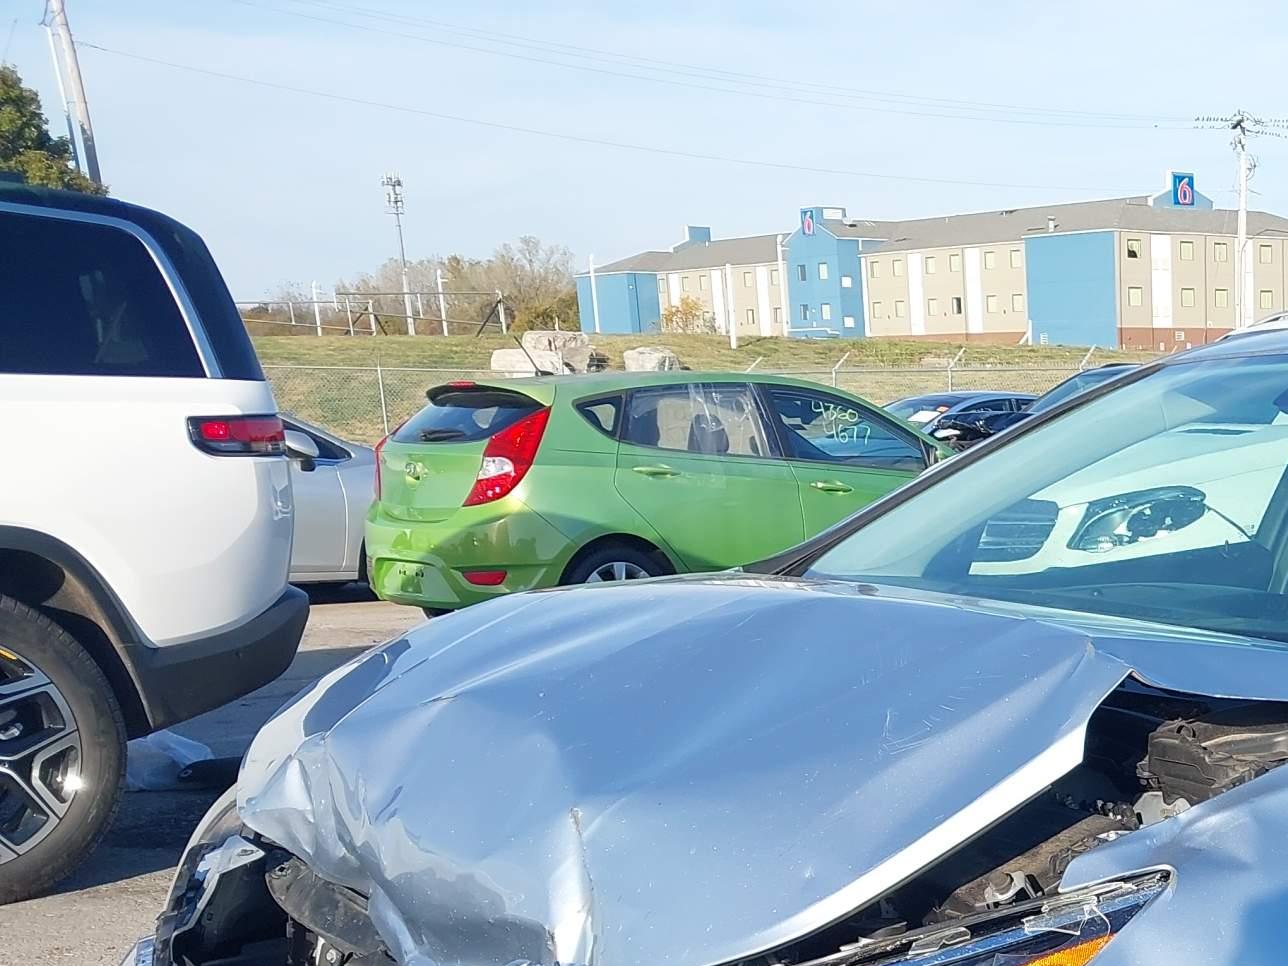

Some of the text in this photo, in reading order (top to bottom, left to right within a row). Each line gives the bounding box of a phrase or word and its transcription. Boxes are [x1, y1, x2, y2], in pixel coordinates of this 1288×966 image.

[1177, 177, 1193, 205] 6
[811, 399, 859, 422] 4360
[822, 420, 871, 446] 4677
